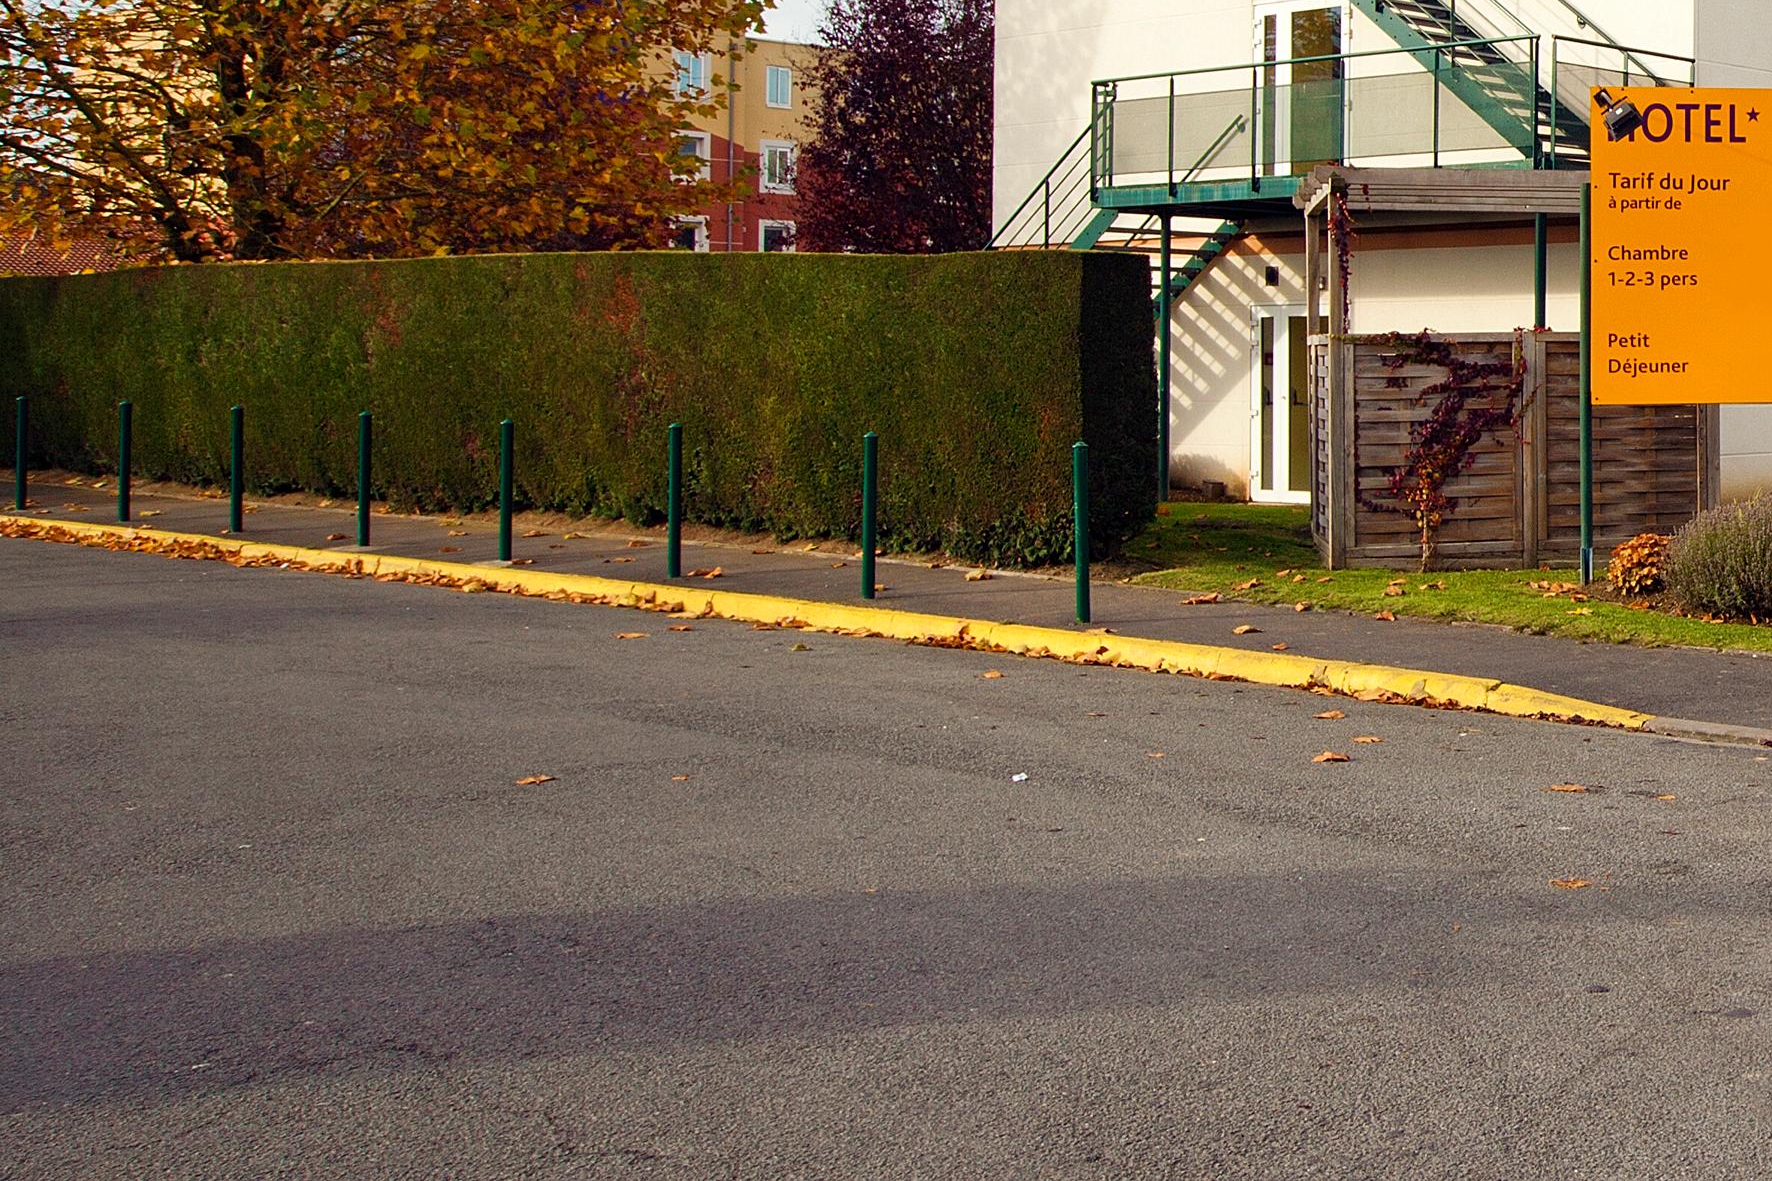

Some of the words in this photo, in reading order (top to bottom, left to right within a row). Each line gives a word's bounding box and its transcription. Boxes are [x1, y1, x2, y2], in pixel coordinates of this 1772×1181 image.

[1608, 172, 1655, 190] Tarif
[1659, 172, 1684, 190] du
[1688, 174, 1731, 195] Jour
[1608, 195, 1617, 209] à
[1620, 196, 1662, 213] partir
[1664, 196, 1682, 210] de
[1607, 245, 1689, 261] Chambre
[1607, 271, 1655, 287] 1-2-3
[1660, 272, 1698, 291] pers
[1607, 332, 1650, 348] Petit
[1607, 358, 1689, 378] Déjeuner
